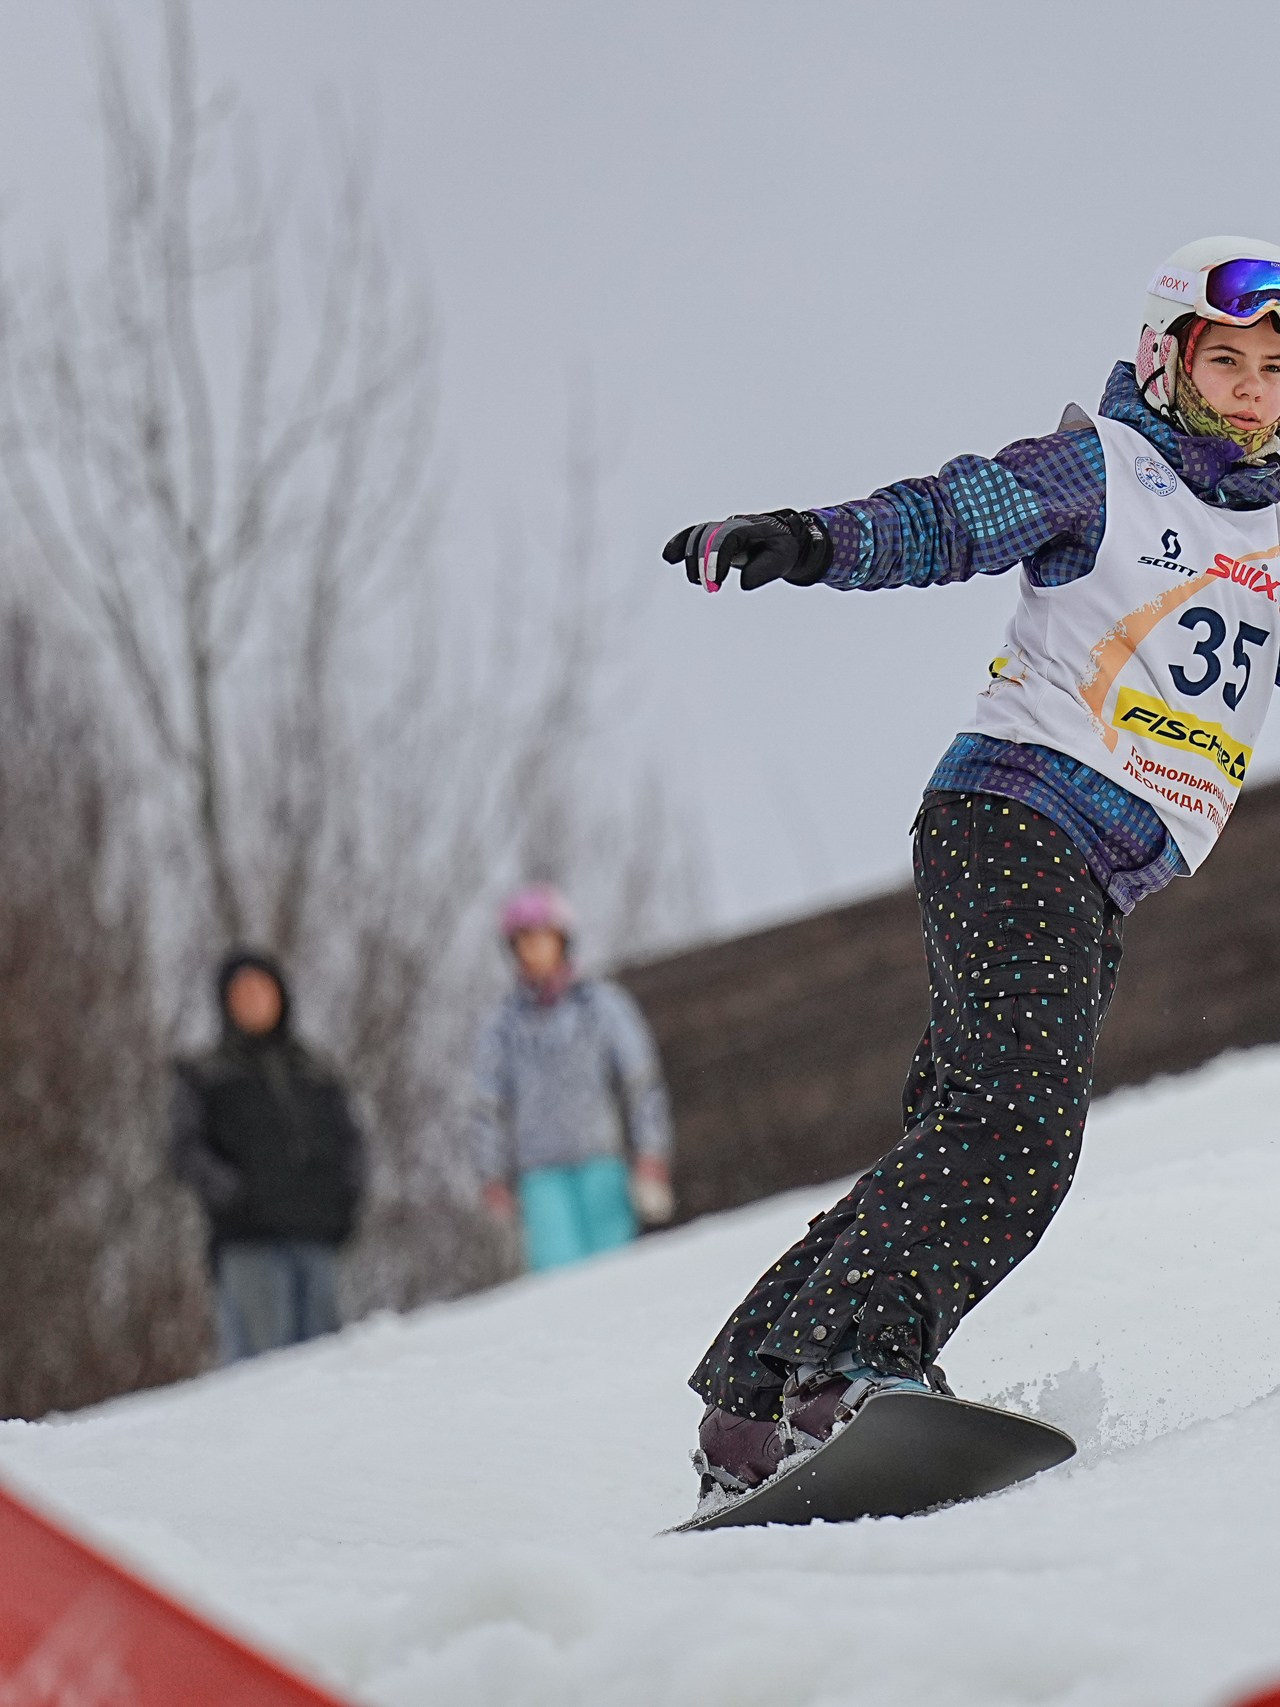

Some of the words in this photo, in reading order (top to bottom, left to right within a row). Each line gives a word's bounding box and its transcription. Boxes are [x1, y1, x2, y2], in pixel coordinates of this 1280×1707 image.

[1160, 275, 1189, 292] ROXY
[1137, 556, 1198, 577] SCOTT
[1168, 607, 1270, 712] 35
[1123, 760, 1203, 814] ЛЕОНИДА
